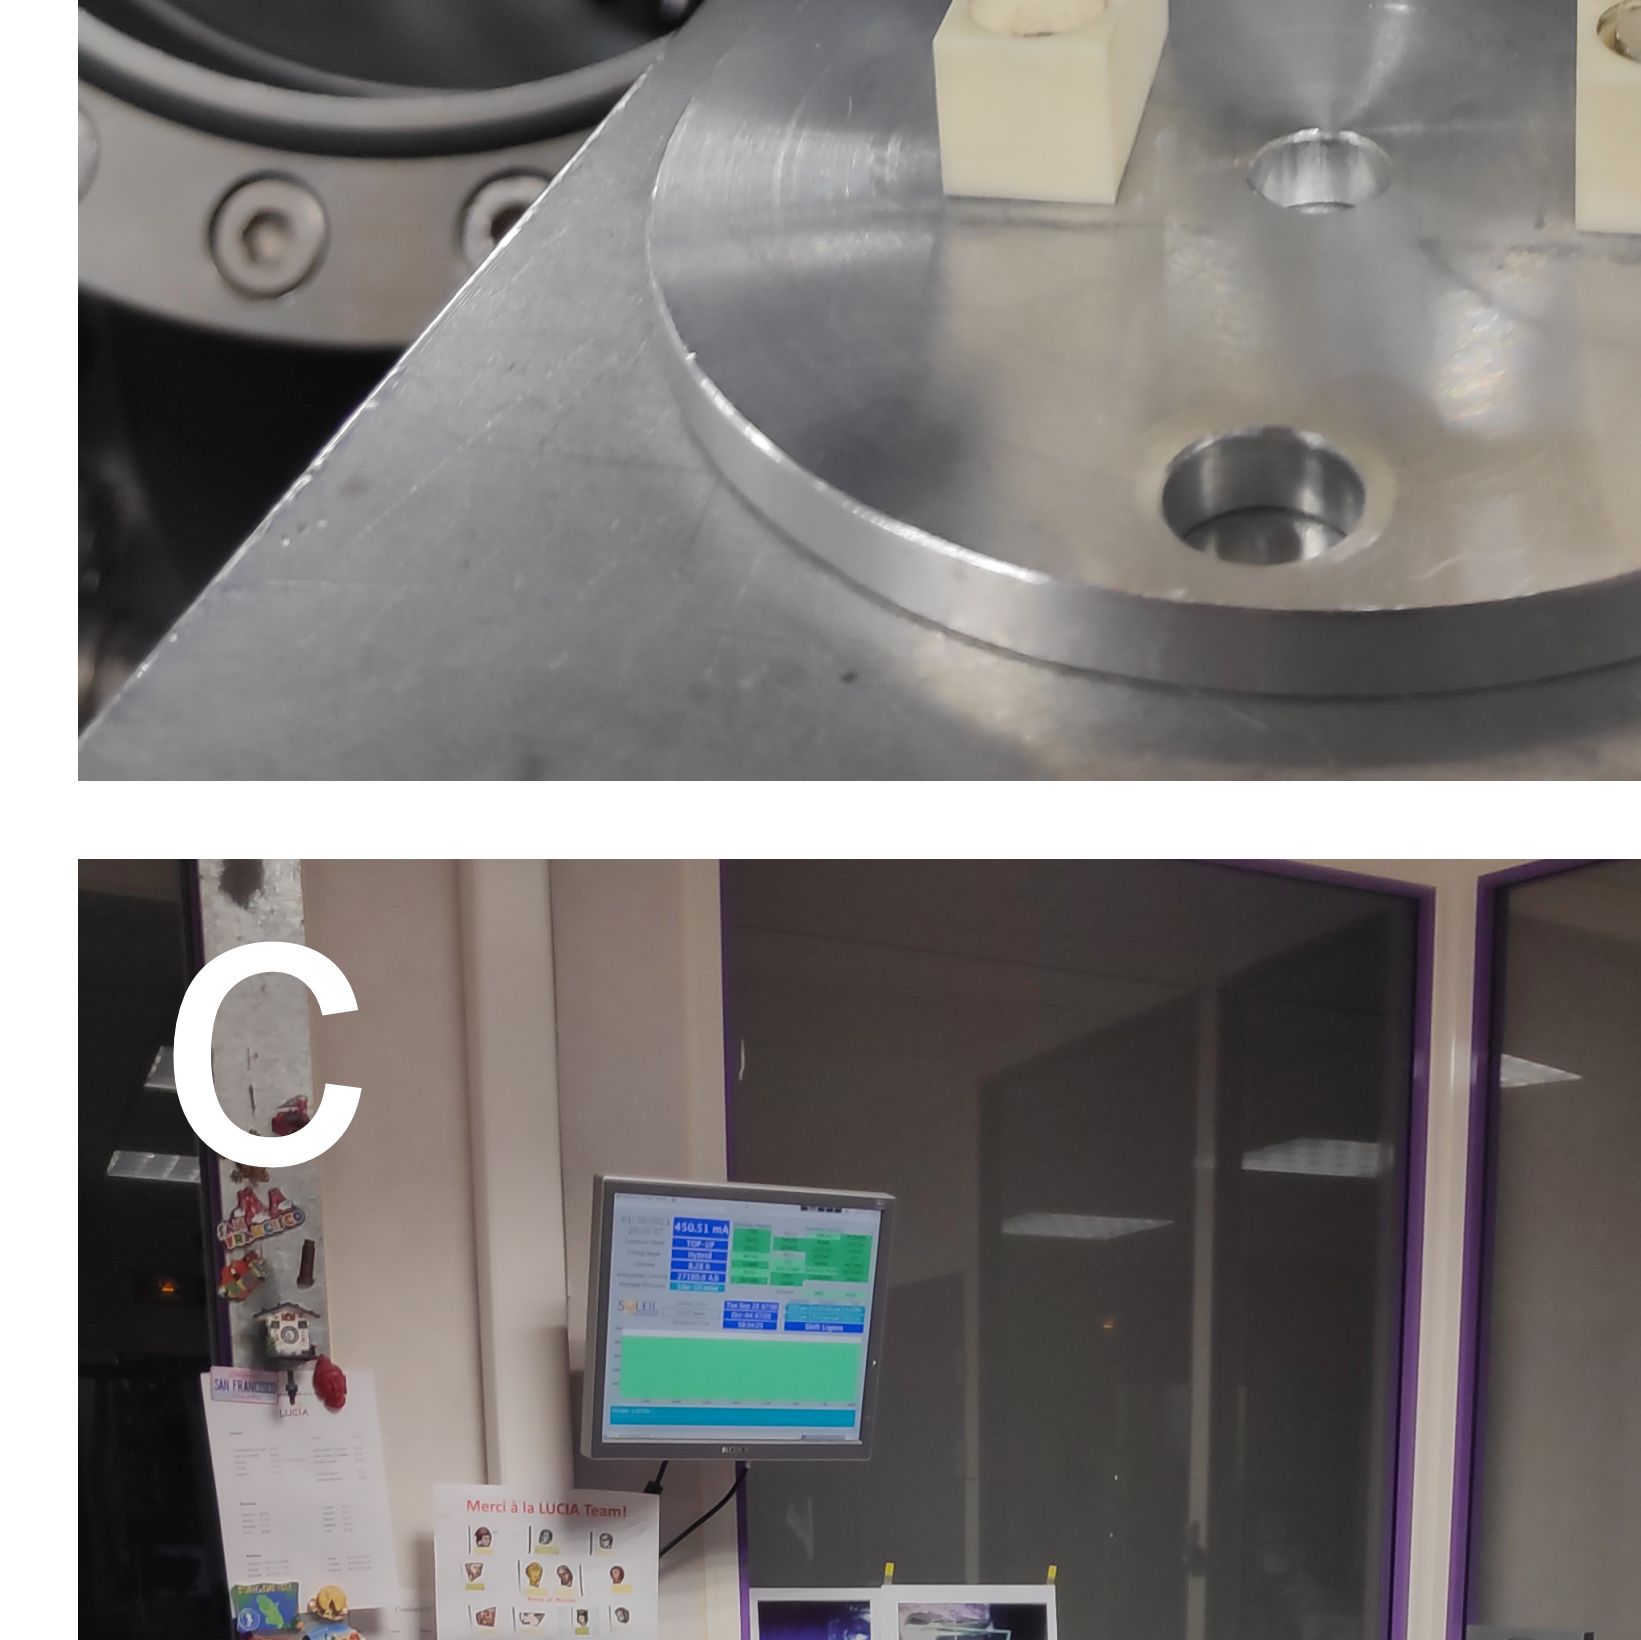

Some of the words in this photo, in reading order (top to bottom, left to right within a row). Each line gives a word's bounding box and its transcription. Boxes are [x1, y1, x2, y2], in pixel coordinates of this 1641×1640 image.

[675, 1221, 709, 1234] 450.51
[712, 1225, 729, 1235] mA
[214, 1378, 230, 1392] SAN
[232, 1379, 277, 1394] FRANCISCO
[279, 1408, 308, 1418] LUCIA
[466, 1499, 506, 1513] Merci
[511, 1501, 518, 1514] à
[523, 1501, 534, 1514] la
[539, 1502, 580, 1516] LUCIA
[584, 1504, 627, 1517] Team!
